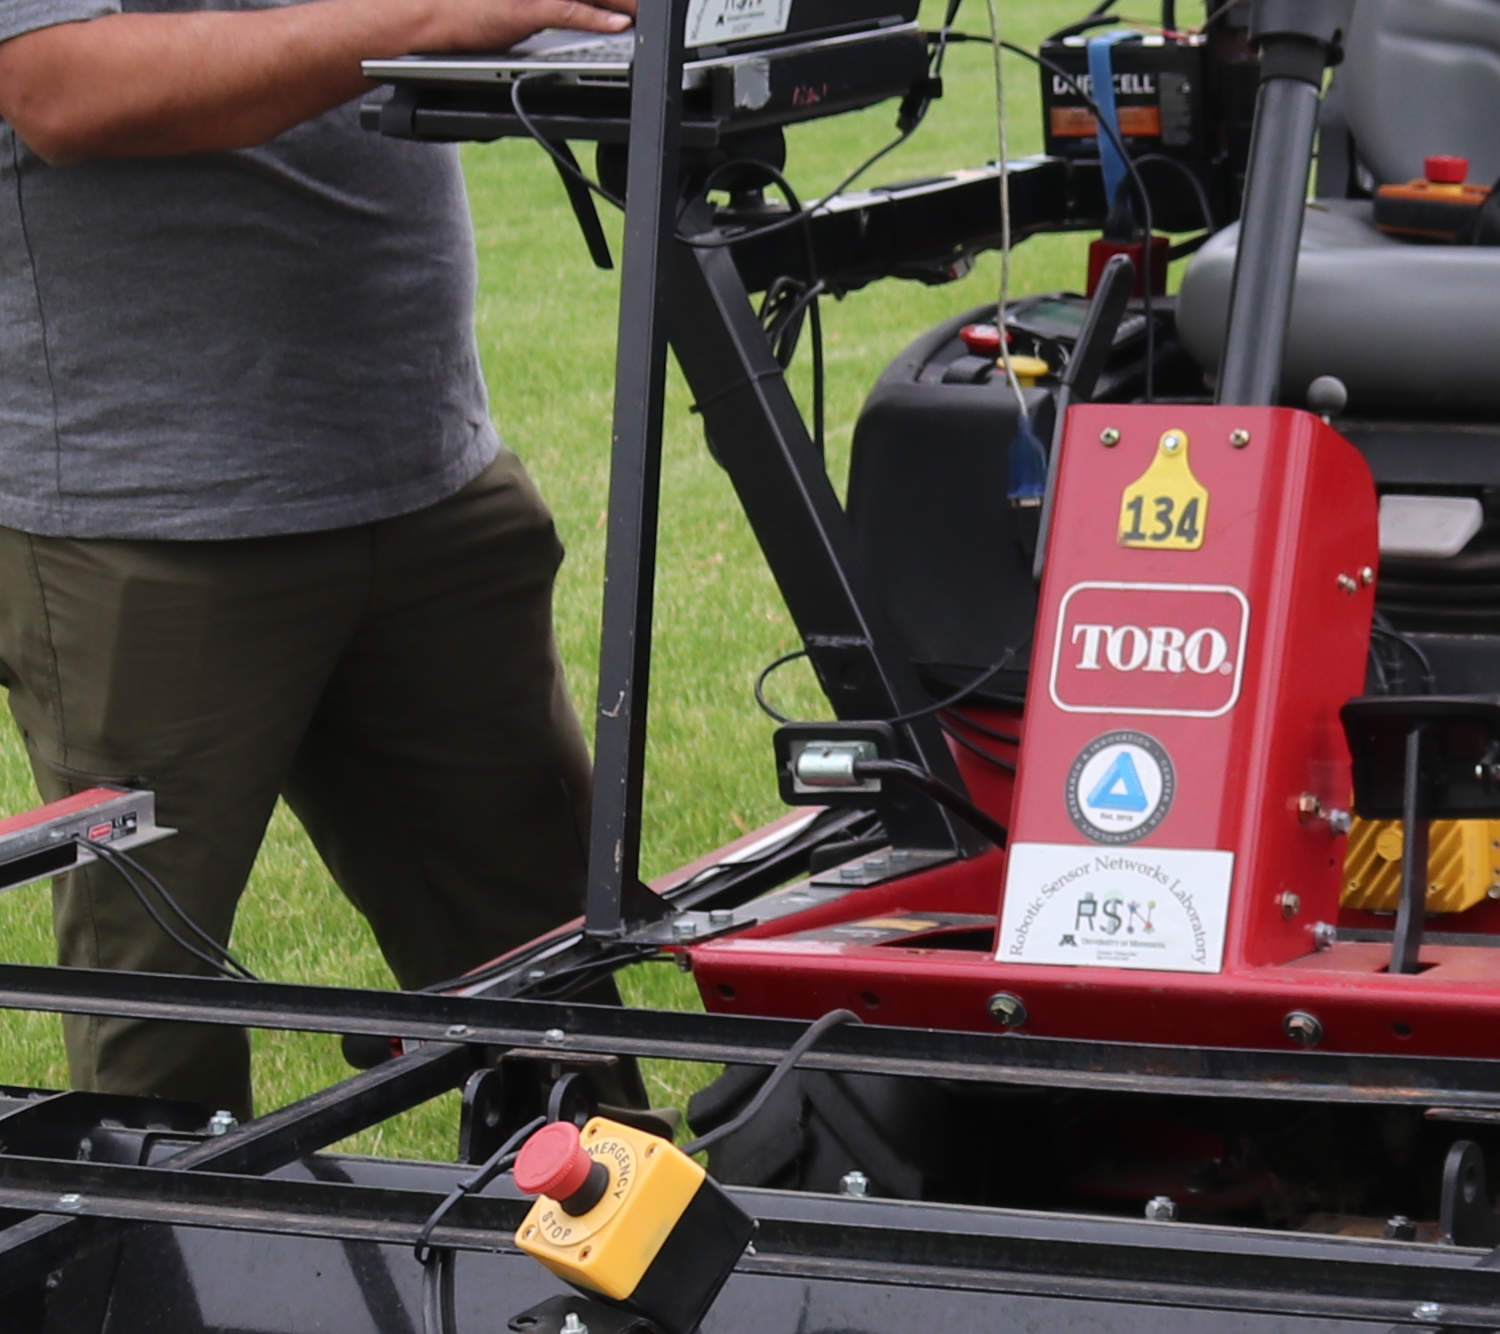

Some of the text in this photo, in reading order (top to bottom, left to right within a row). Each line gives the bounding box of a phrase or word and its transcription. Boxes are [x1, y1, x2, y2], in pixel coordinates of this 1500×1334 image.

[1052, 73, 1156, 95] DURCELL
[1122, 496, 1200, 543] 134
[1071, 624, 1228, 675] TORO
[1010, 855, 1208, 965] Robotic Sensor Networks Laboratory
[587, 1142, 631, 1200] MERGENCY
[542, 1211, 573, 1241] STOP
